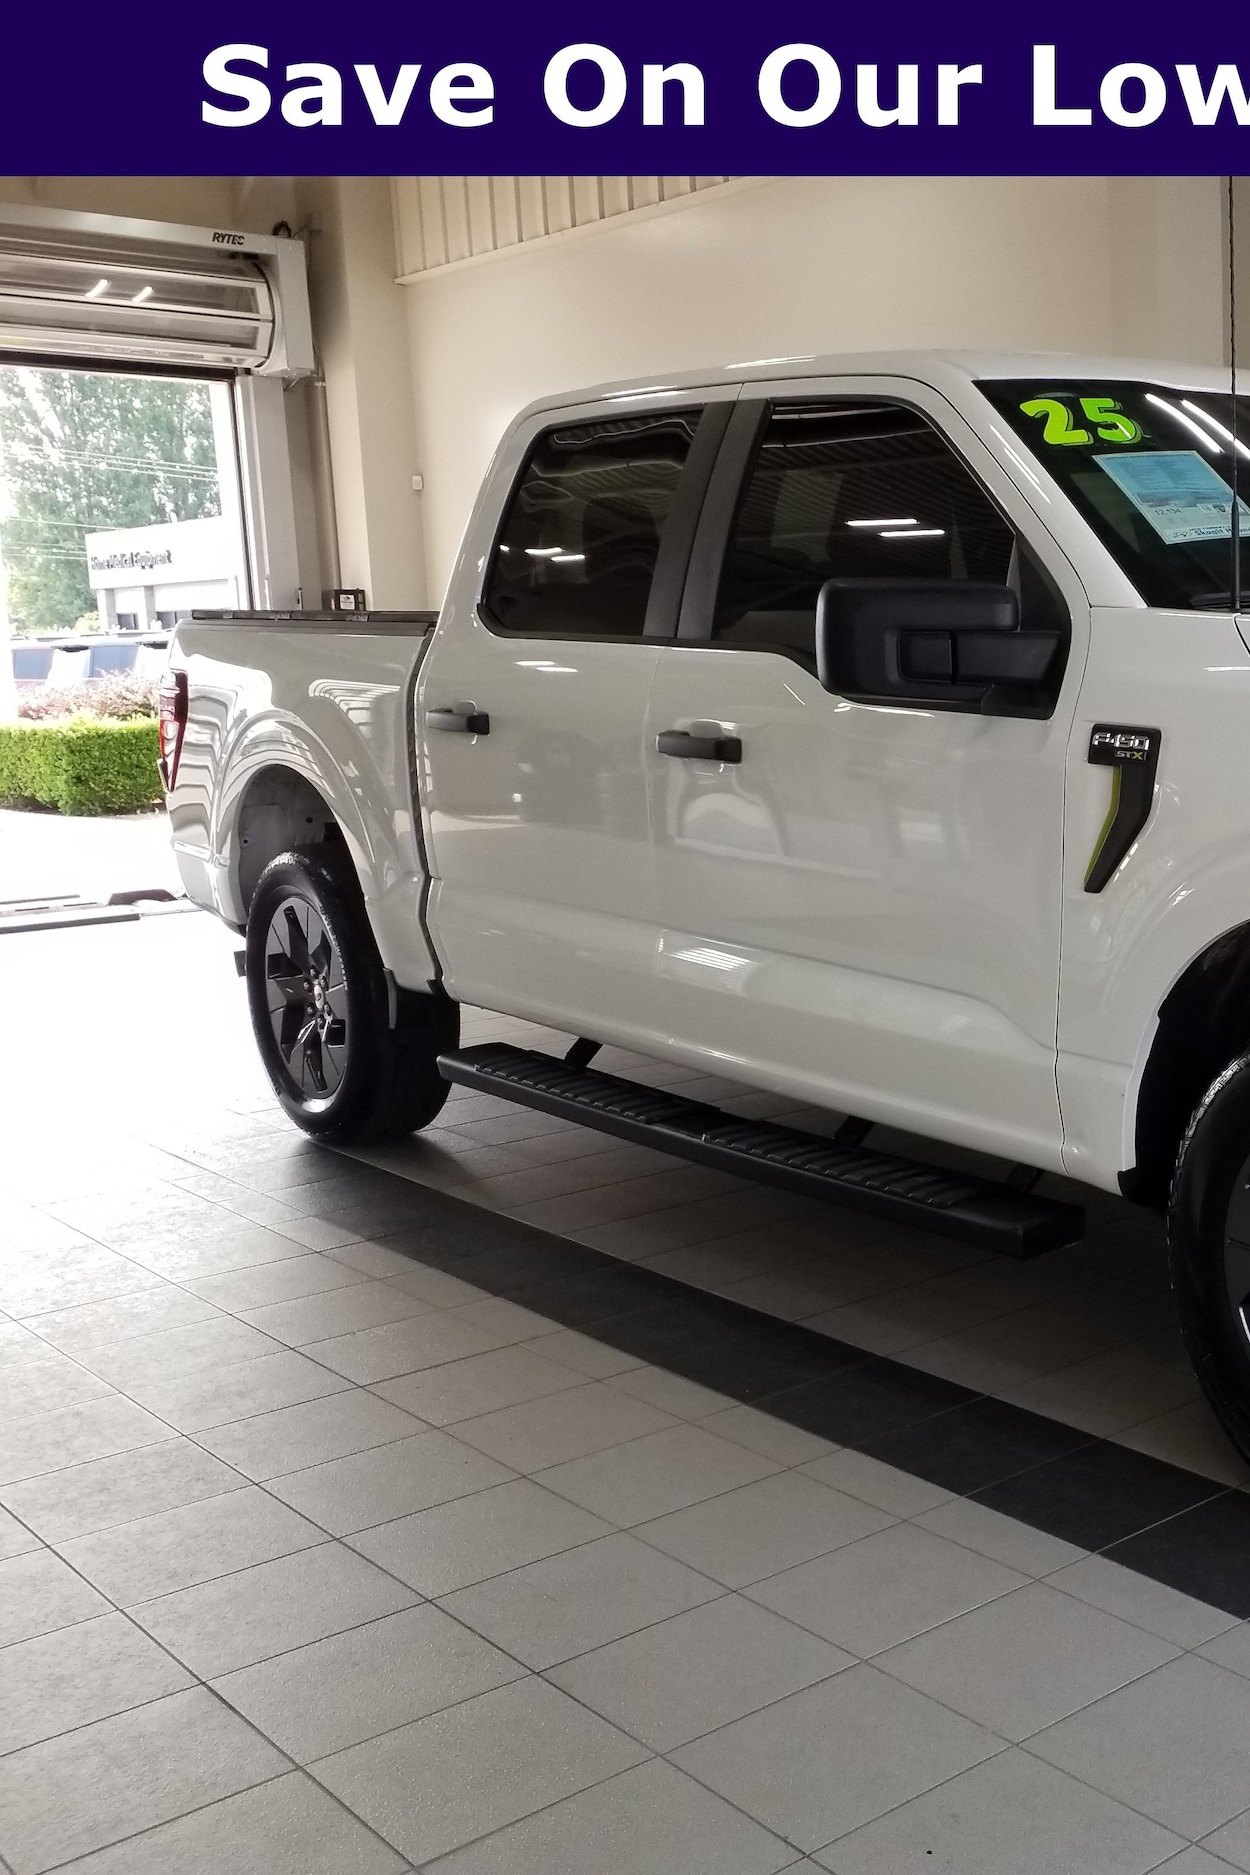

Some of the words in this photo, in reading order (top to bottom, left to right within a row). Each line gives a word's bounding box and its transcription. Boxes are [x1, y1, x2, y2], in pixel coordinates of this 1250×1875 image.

[212, 231, 245, 246] RYTEC
[1019, 397, 1142, 446] 25
[1194, 529, 1224, 537] Skagit
[1115, 750, 1144, 761] STX
